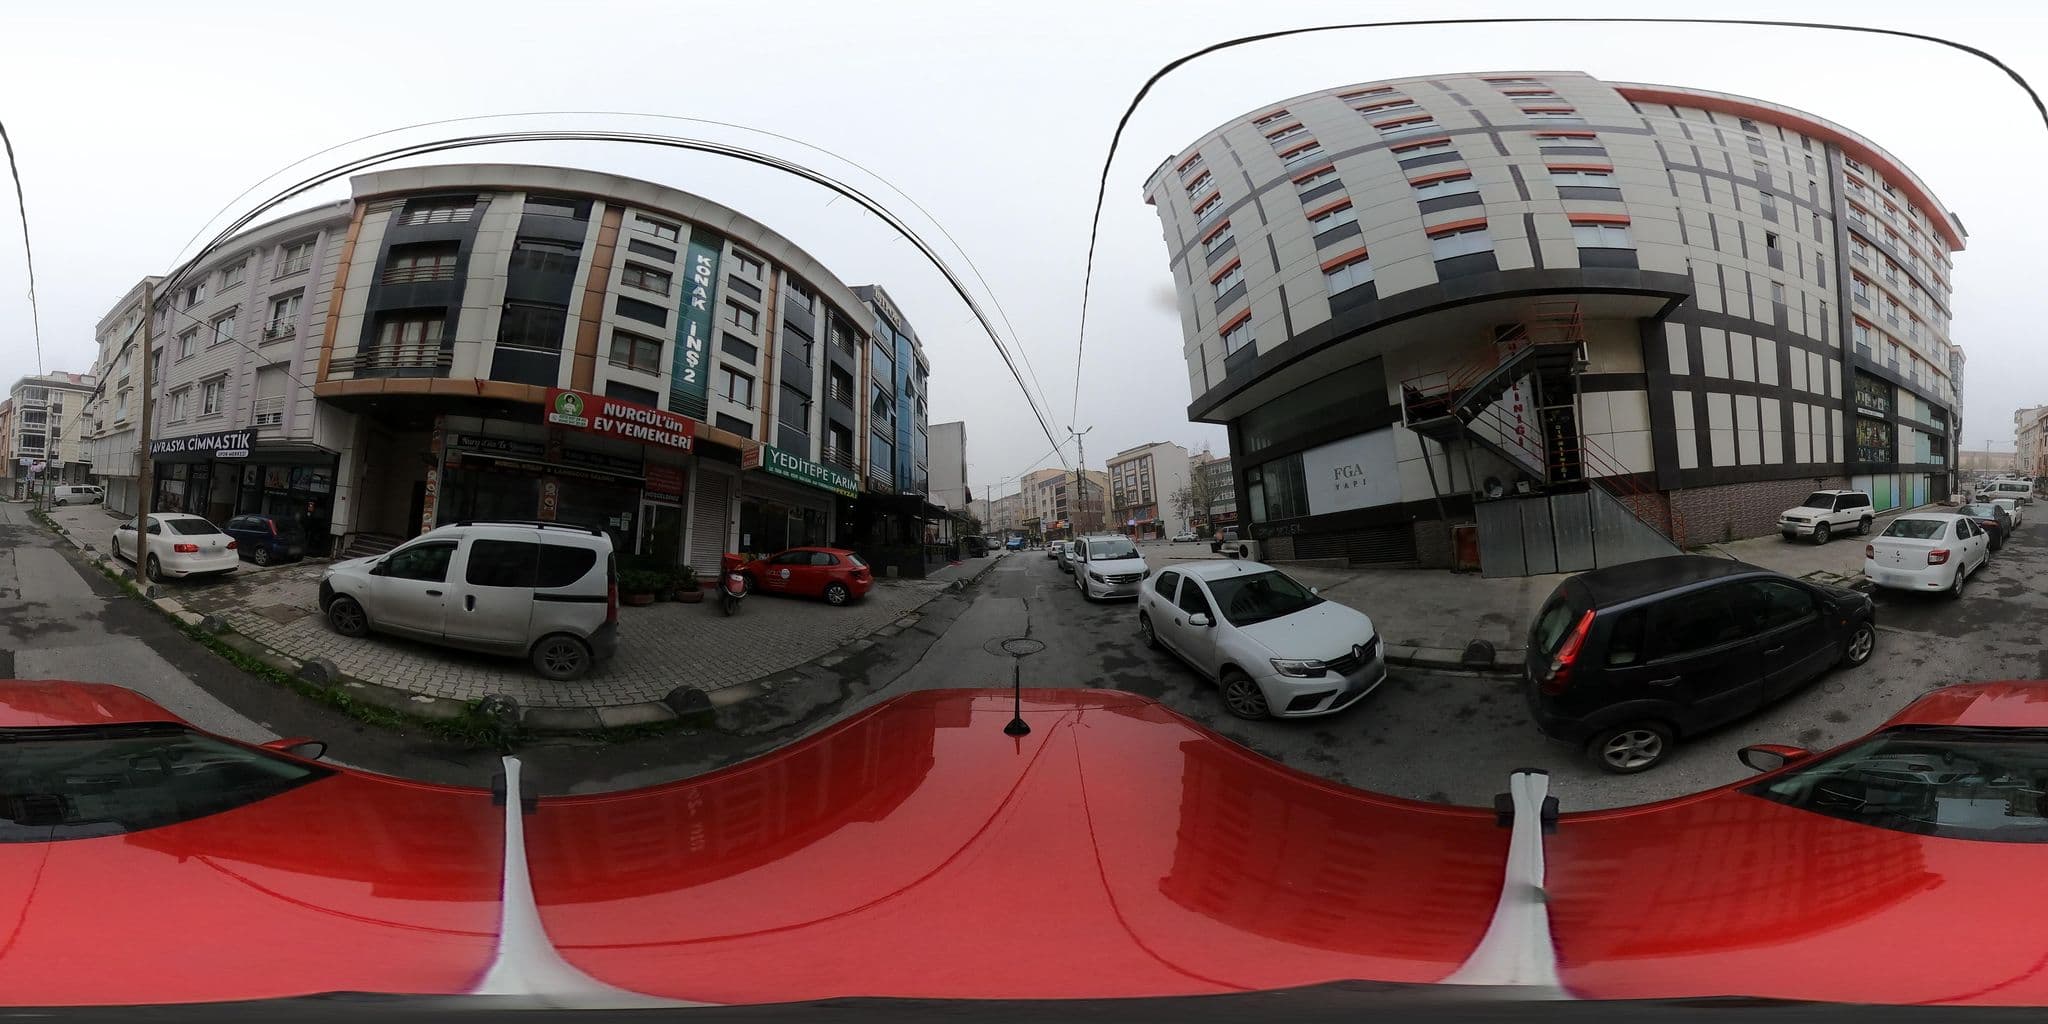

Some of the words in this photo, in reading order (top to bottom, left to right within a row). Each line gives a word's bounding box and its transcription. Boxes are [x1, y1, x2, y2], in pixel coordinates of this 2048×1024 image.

[691, 254, 712, 312] KONAK
[152, 438, 186, 454] AVRASYA
[188, 430, 251, 451] CİMNASTİK
[593, 416, 614, 432] EV
[615, 419, 692, 451] YEMEKLERİ
[770, 448, 829, 482] YEDİTEPE
[830, 471, 858, 492] TARIM
[1333, 463, 1363, 481] FGA
